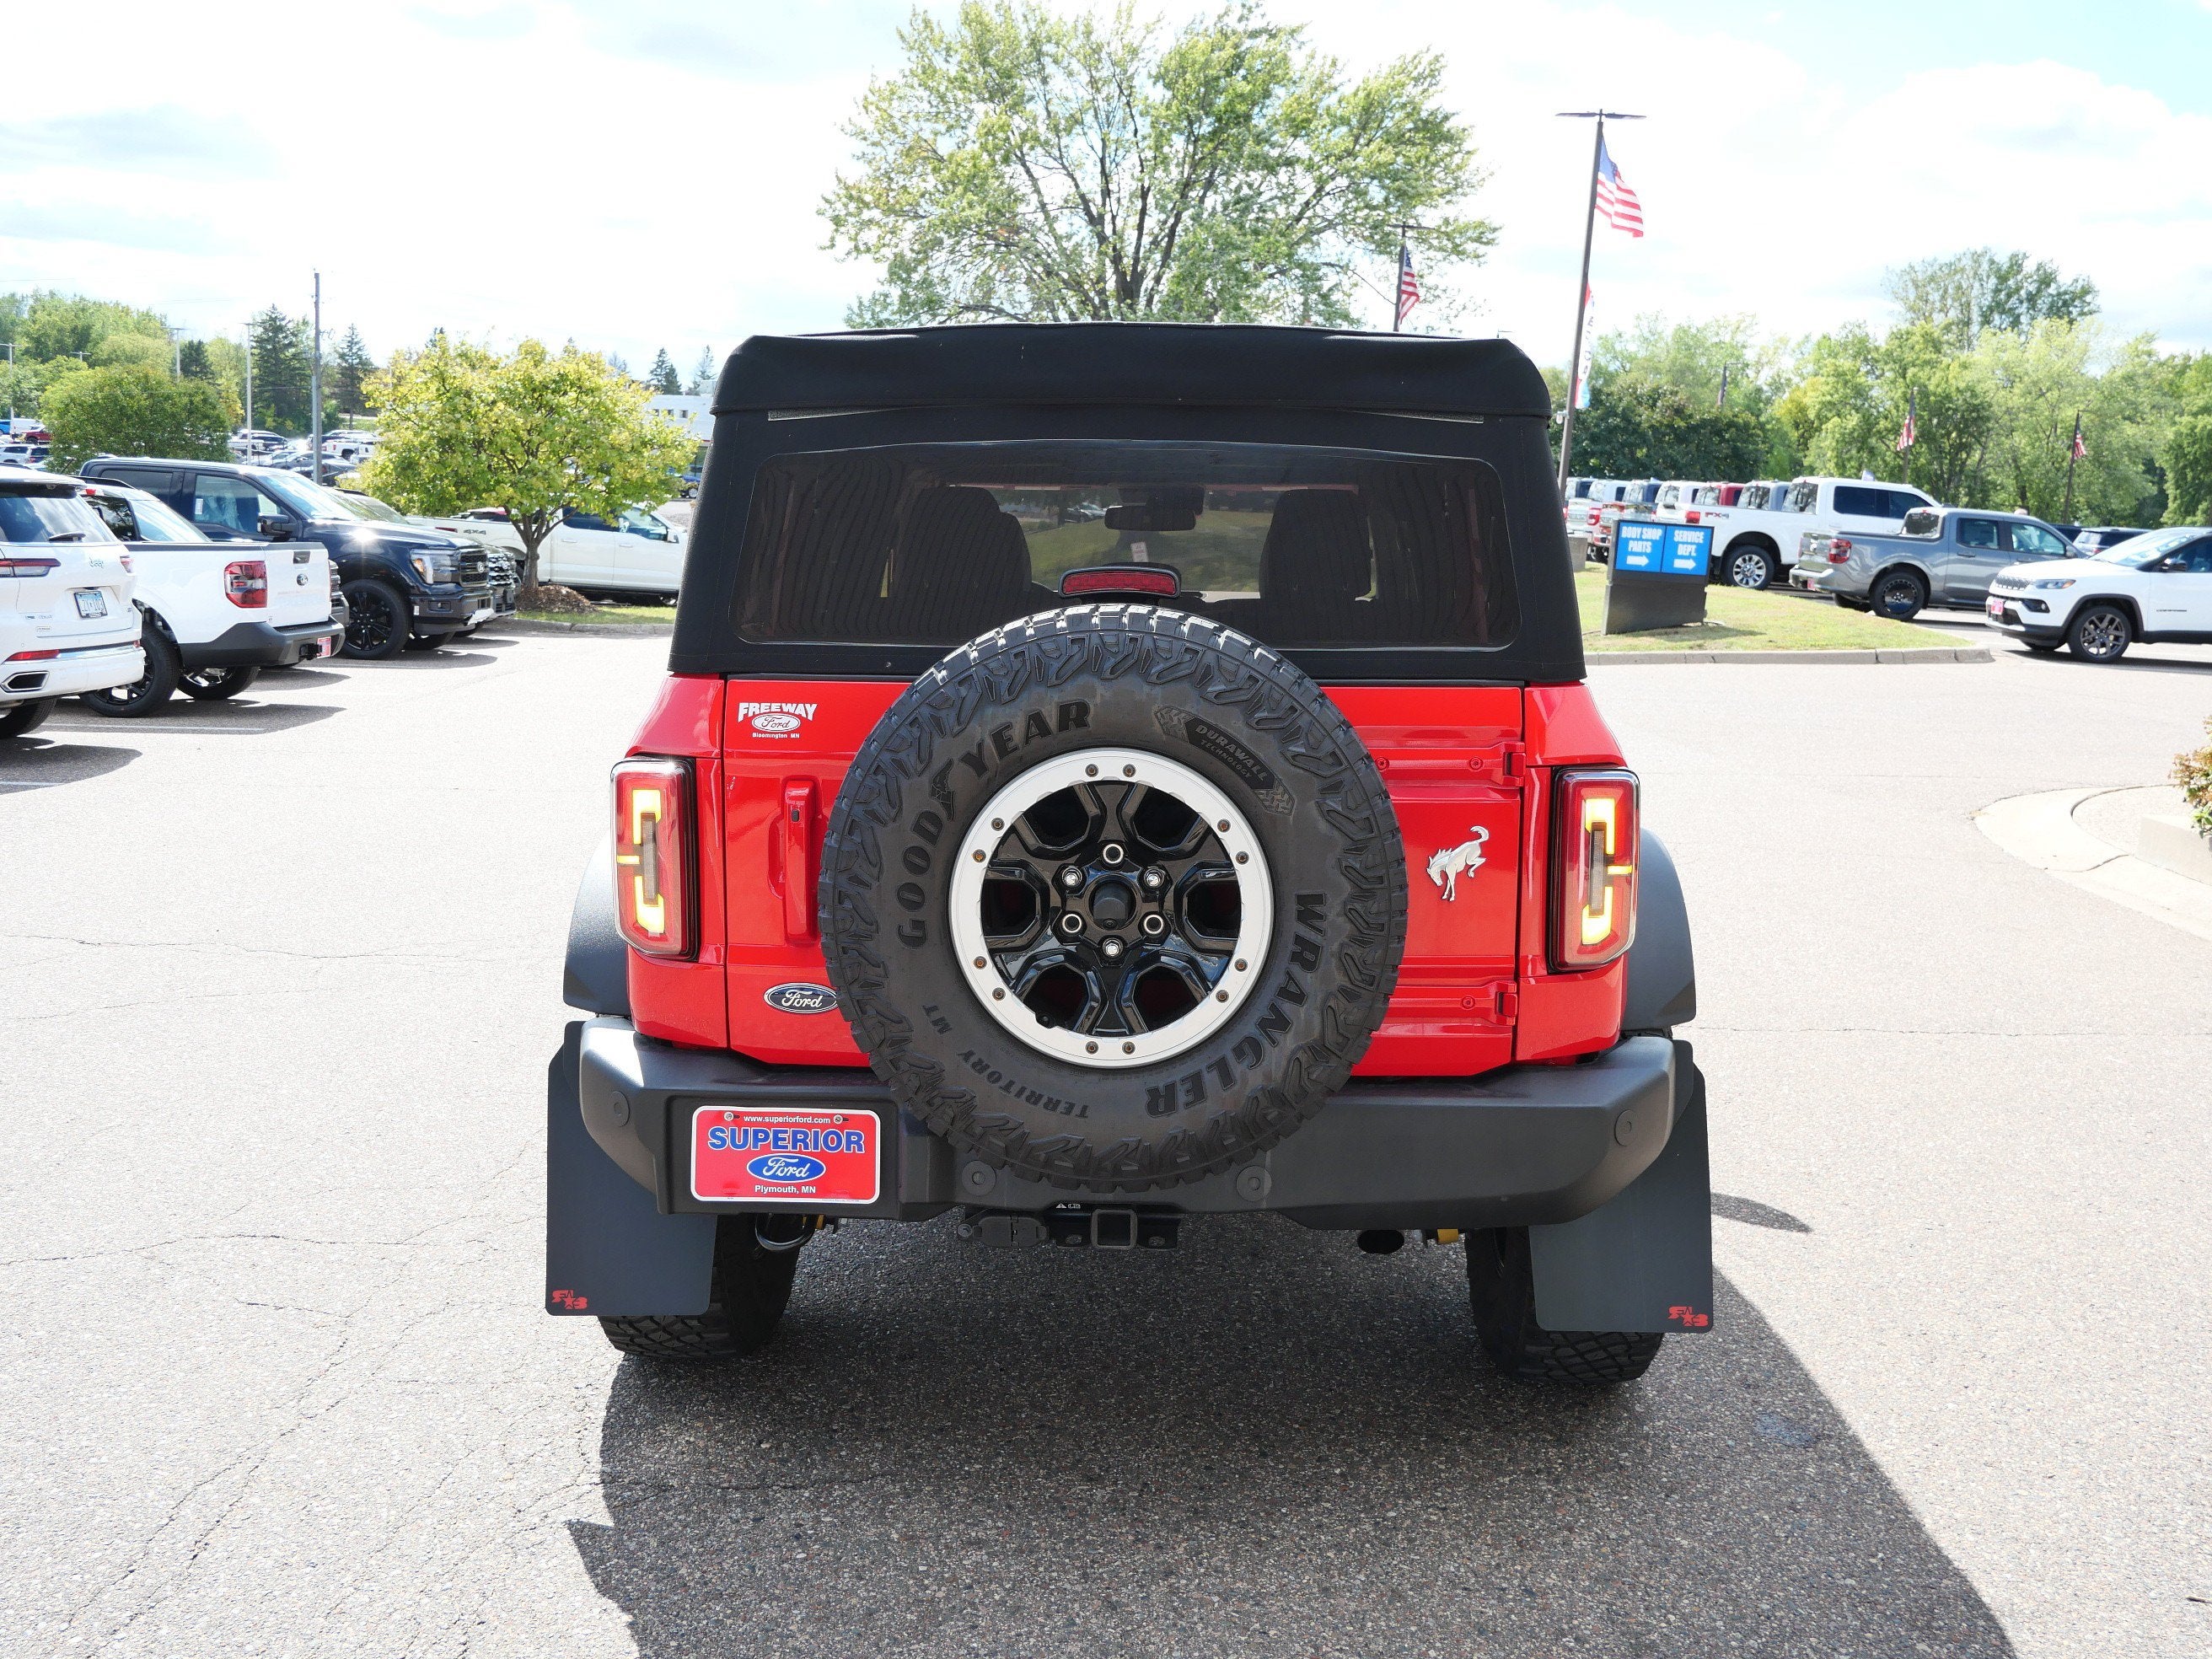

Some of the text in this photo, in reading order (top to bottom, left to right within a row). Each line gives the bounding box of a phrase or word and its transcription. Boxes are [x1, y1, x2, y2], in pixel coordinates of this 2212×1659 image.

[1621, 526, 1662, 540] BODY SHOP
[1673, 529, 1705, 544] SERVICE
[1628, 540, 1652, 553] PARTS
[1678, 544, 1697, 556] DEPT.
[738, 702, 818, 722] FREEWAY
[761, 717, 791, 727] Ford
[1195, 724, 1268, 781] DURAWALL
[1200, 738, 1254, 779] TECHNOLOGY
[781, 989, 824, 1007] Ford
[1146, 892, 1326, 1118] WRANGLER
[922, 1004, 1089, 1119] TERRITORY MT
[743, 1114, 830, 1125] www.superiorford.com
[707, 1126, 866, 1154] SUPERIOR
[762, 1157, 811, 1178] Ford
[754, 1184, 816, 1195] Plymouth, MN
